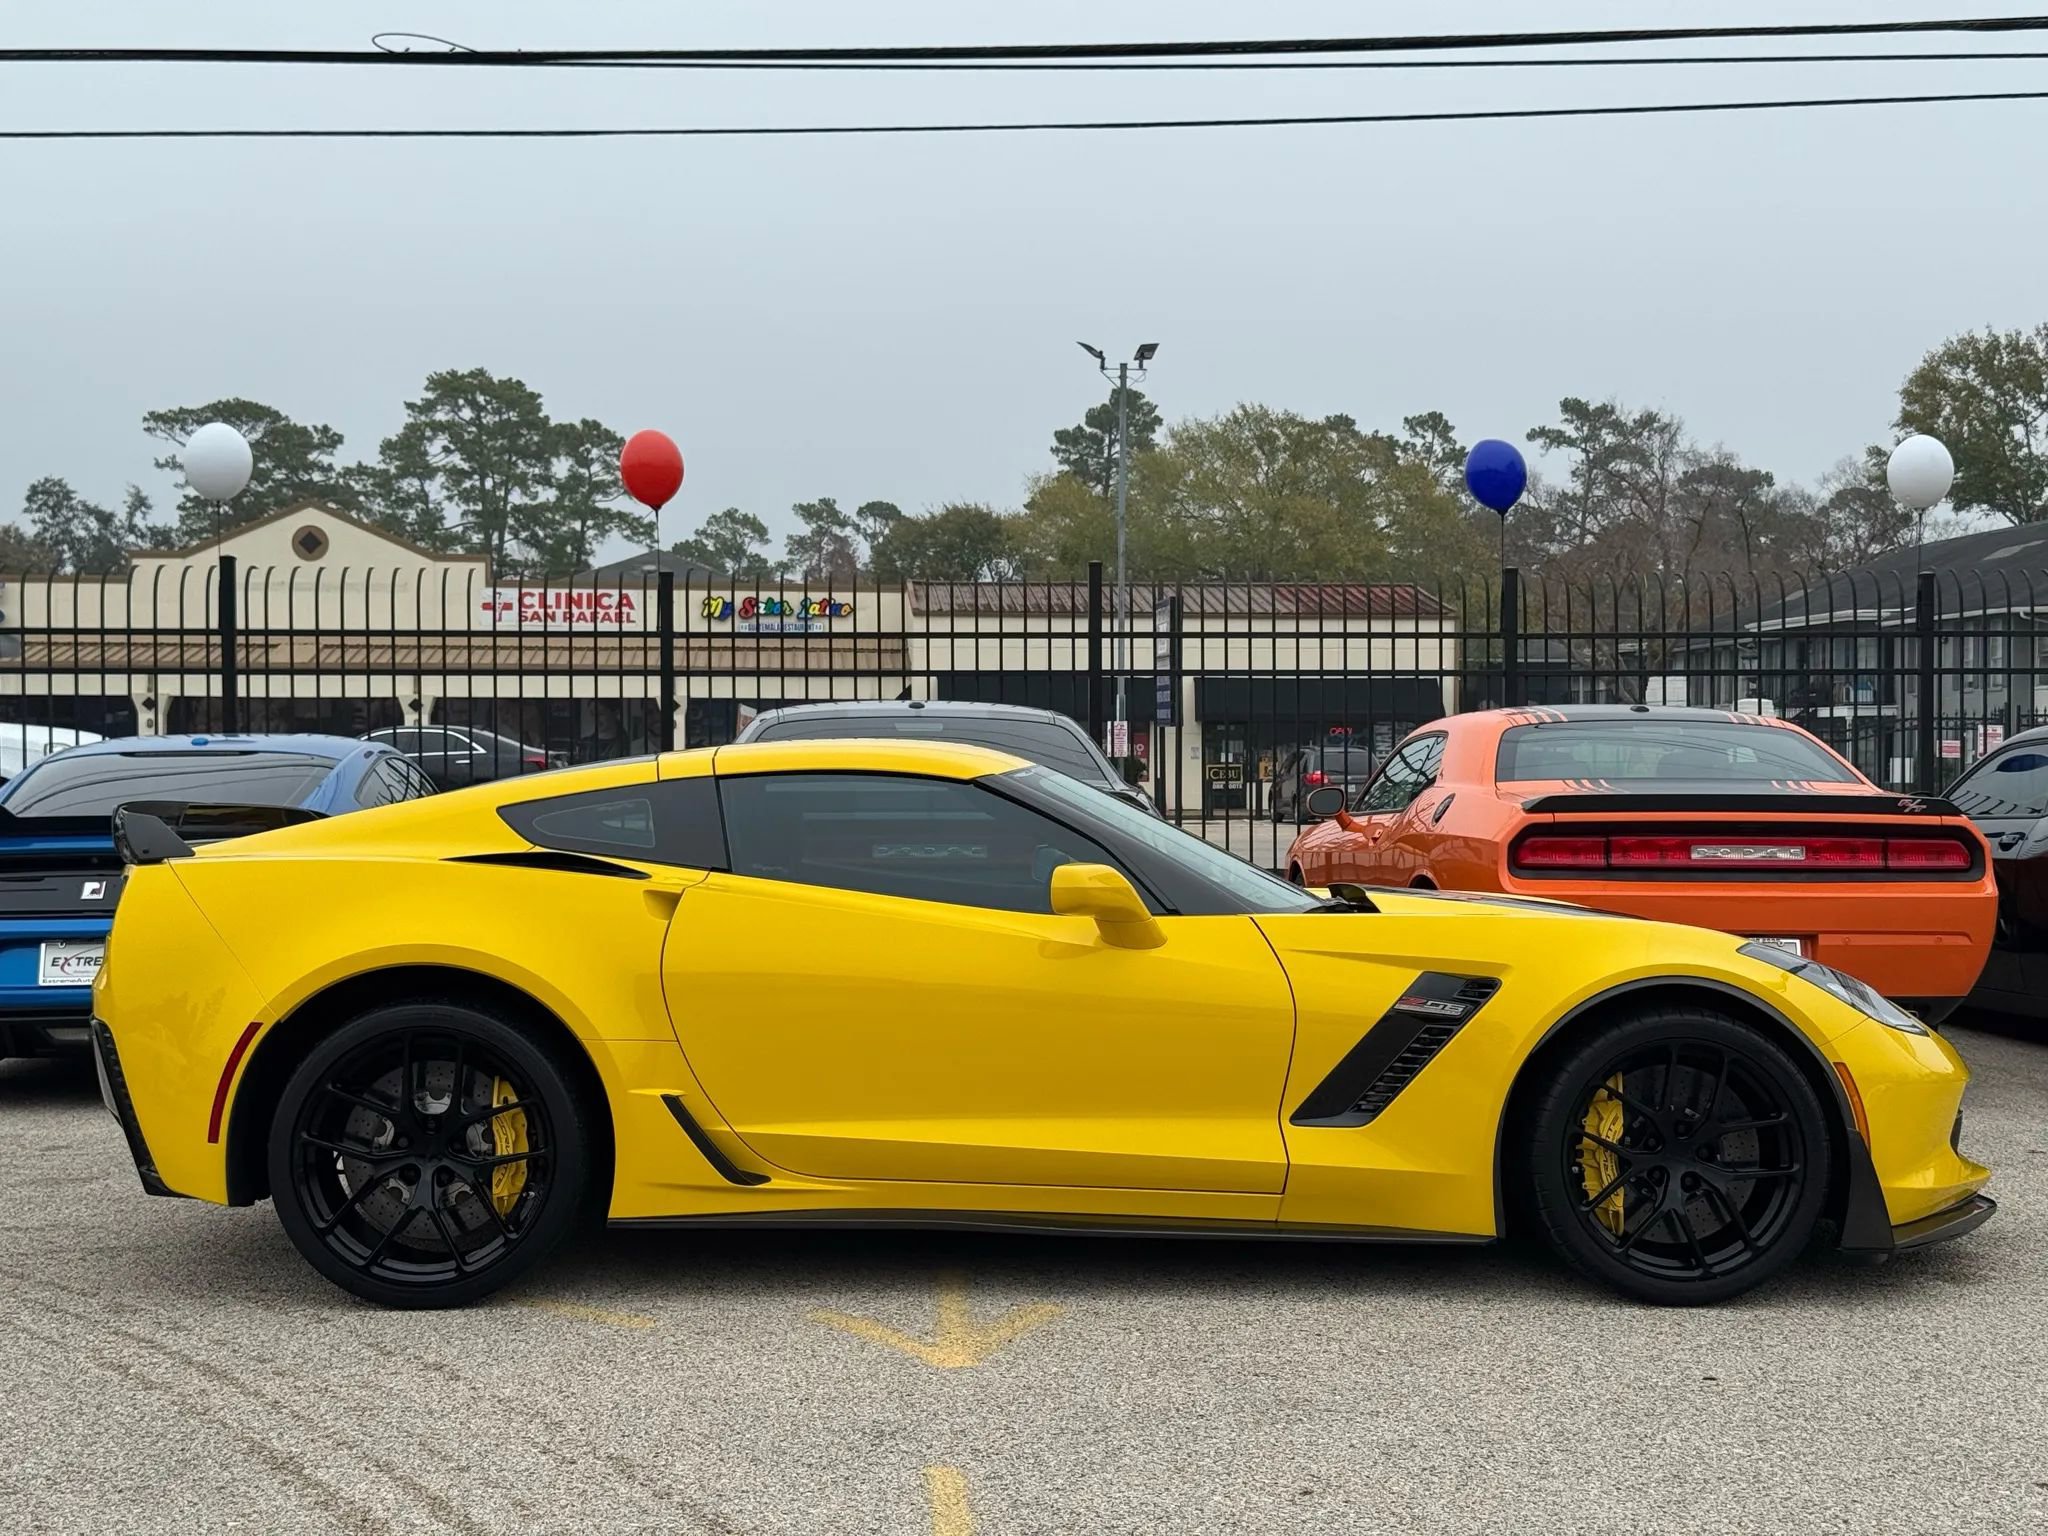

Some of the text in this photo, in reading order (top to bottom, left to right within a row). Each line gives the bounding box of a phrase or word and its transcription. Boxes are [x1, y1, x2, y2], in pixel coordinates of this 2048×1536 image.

[519, 592, 636, 610] CLINICA
[701, 596, 735, 621] My
[519, 611, 636, 623] SAN RAFAEL
[1694, 846, 1803, 858] DODGE
